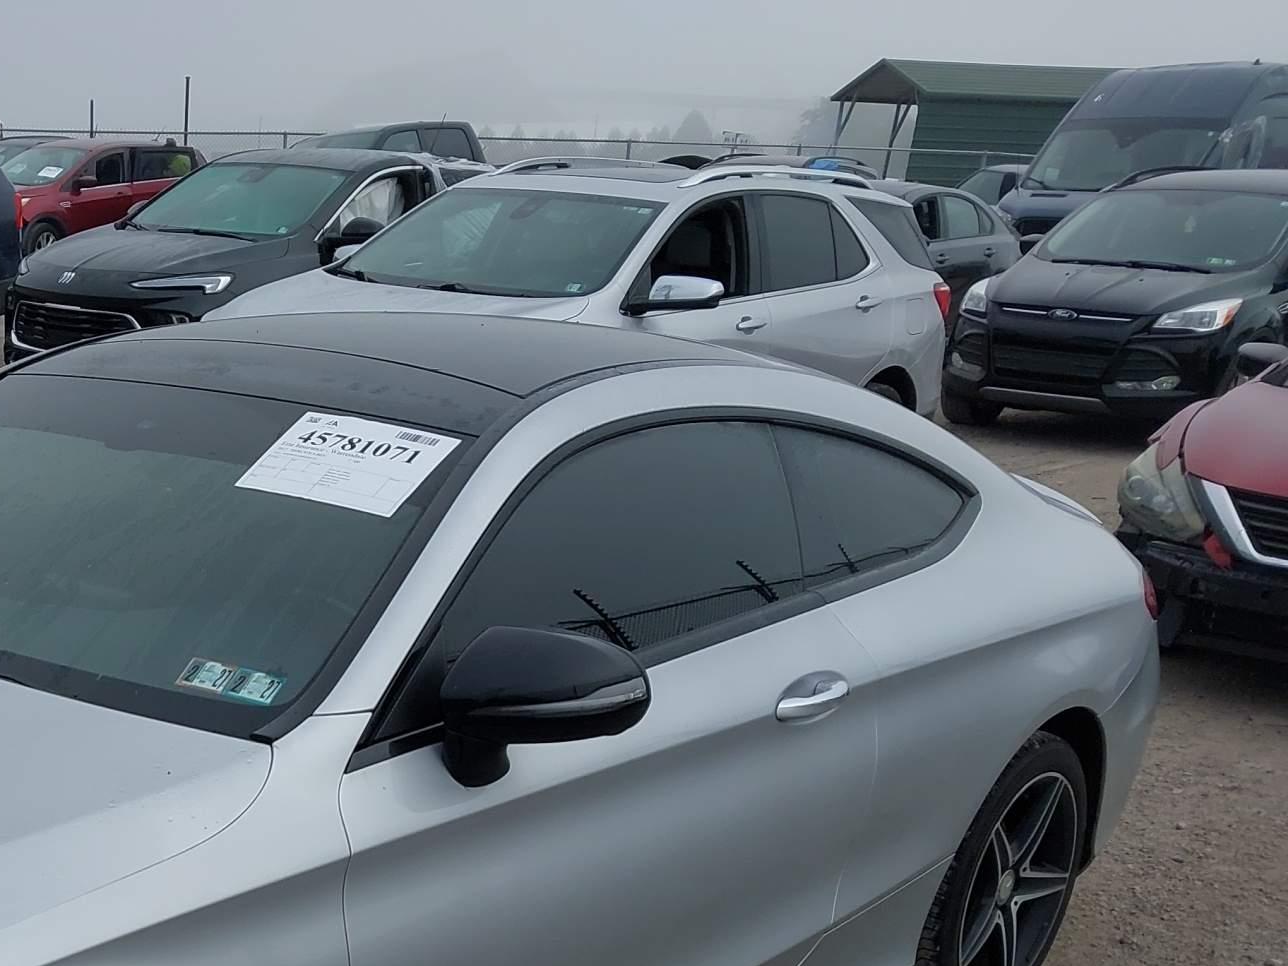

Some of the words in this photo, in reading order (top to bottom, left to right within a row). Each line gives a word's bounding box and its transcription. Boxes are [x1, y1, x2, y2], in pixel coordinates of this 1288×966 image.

[297, 430, 422, 465] 45781071
[184, 665, 200, 682] 2
[231, 676, 246, 693] 2
